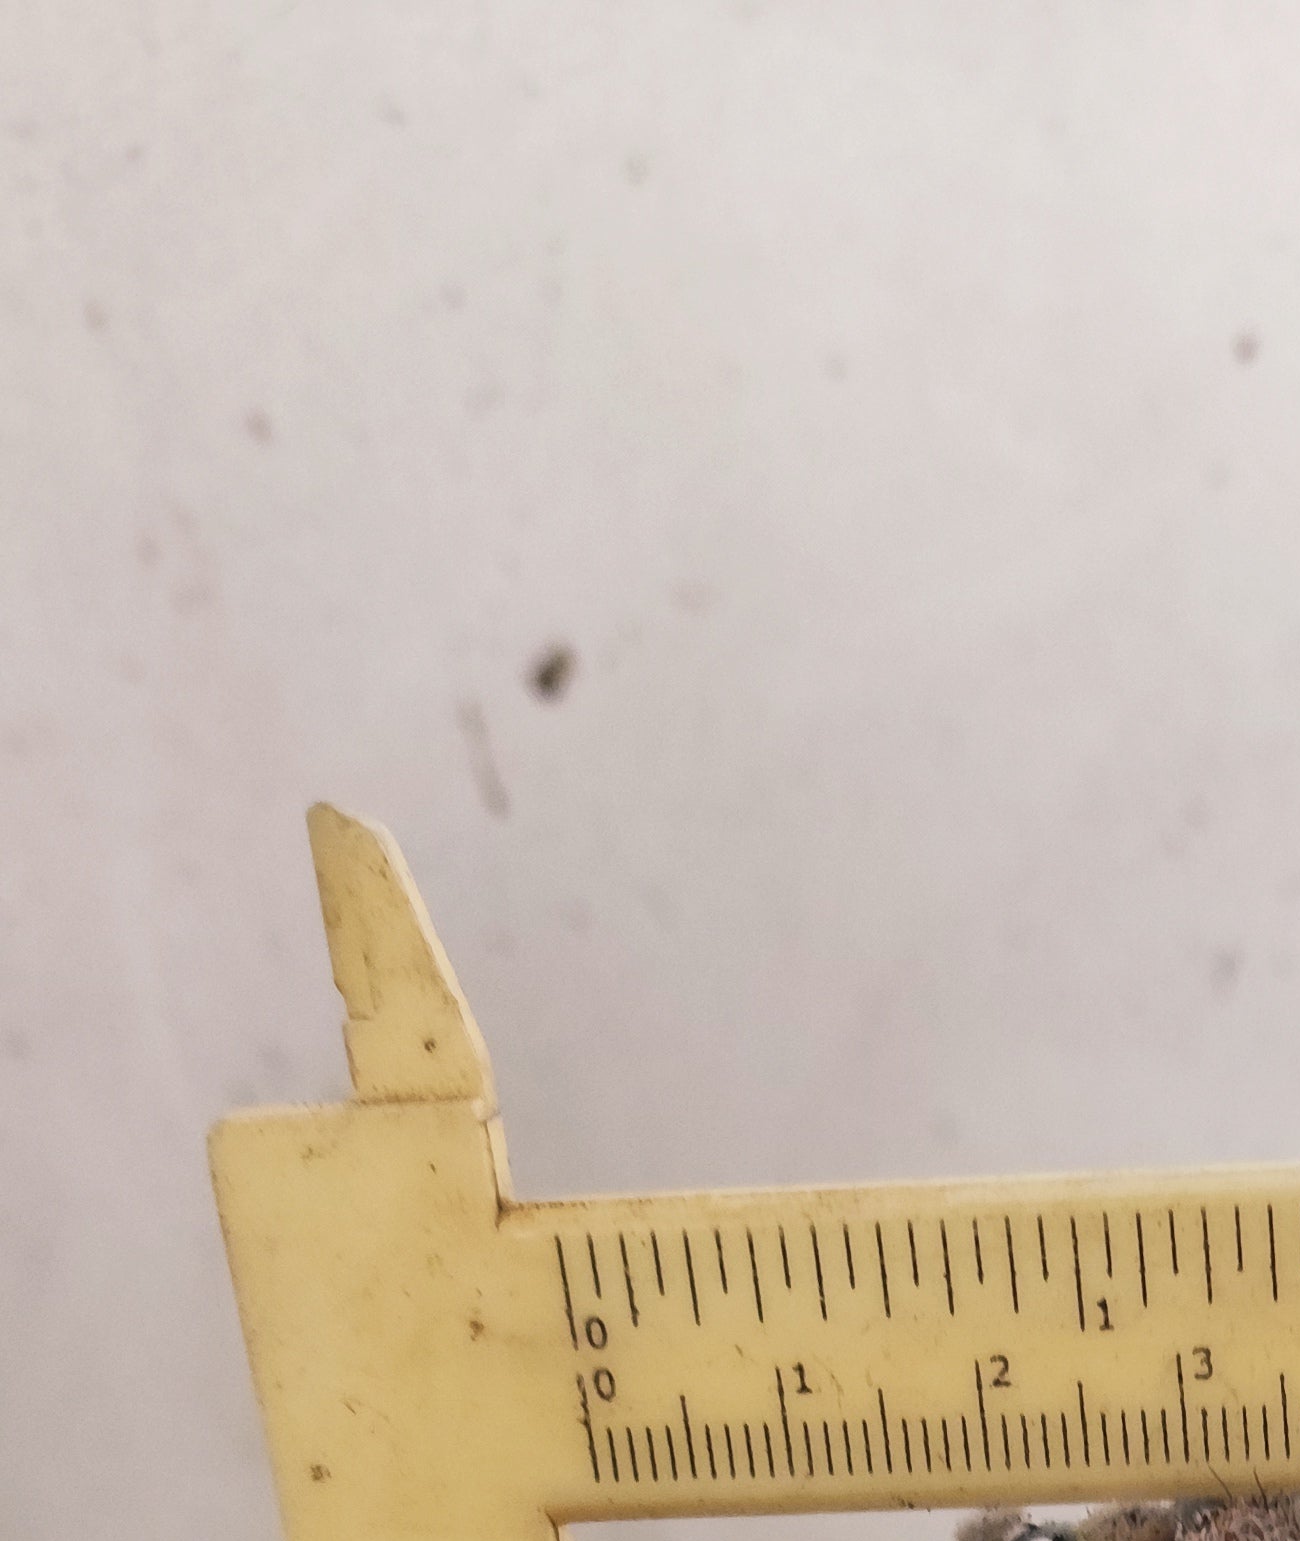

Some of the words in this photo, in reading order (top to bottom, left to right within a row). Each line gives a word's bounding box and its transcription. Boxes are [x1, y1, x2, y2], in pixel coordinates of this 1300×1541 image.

[585, 1314, 609, 1351] 0
[1095, 1298, 1115, 1331] 1
[593, 1367, 617, 1402] 0
[793, 1363, 814, 1395] 1
[989, 1354, 1013, 1388] 2
[1192, 1346, 1215, 1381] 3
